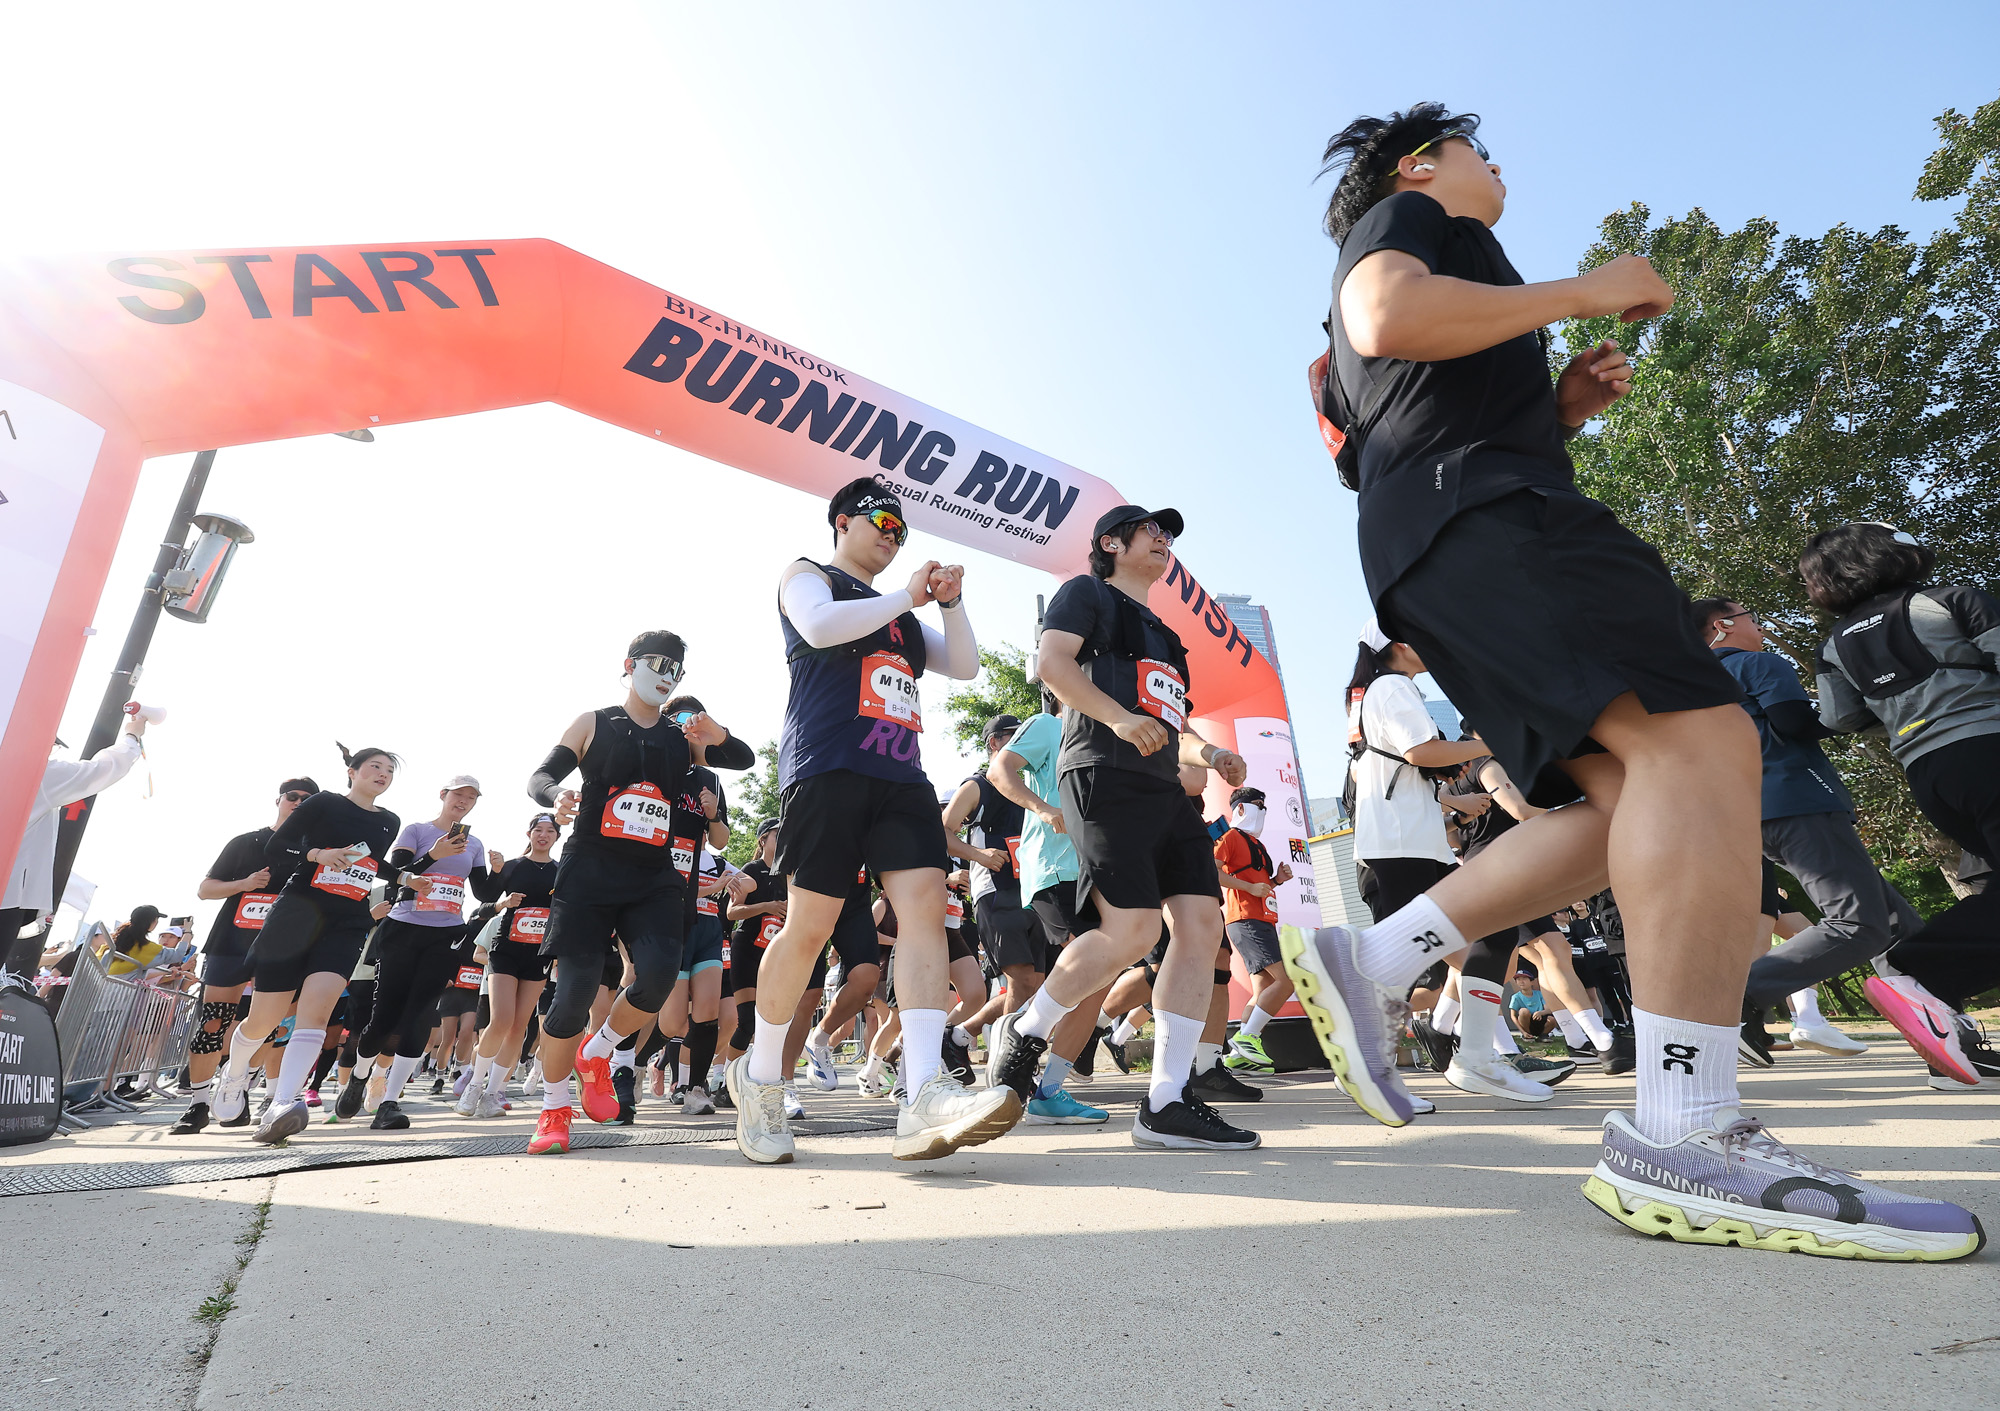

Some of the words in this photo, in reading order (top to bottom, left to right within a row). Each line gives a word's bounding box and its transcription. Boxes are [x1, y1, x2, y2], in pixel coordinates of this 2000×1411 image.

[107, 248, 500, 325] START
[623, 316, 956, 485] BURNING
[954, 450, 1080, 530] RUN
[873, 473, 929, 503] Casual
[929, 494, 993, 528] Running
[995, 518, 1051, 546] Festival
[1165, 549, 1253, 668] NISH
[879, 674, 892, 687] M
[896, 677, 919, 704] 1871
[1153, 678, 1164, 689] M
[892, 704, 907, 714] B-51
[620, 801, 632, 810] M
[637, 801, 668, 820] 1884
[628, 824, 648, 834] B-281
[672, 852, 692, 865] 574
[321, 875, 340, 883] C-223
[342, 867, 374, 883] 4585
[439, 886, 462, 898] 3581
[0, 1031, 25, 1065] TART
[0, 1073, 31, 1105] ITING
[33, 1075, 55, 1104] LINE
[1603, 1145, 1628, 1168] ON
[1631, 1157, 1744, 1206] RUNNING
